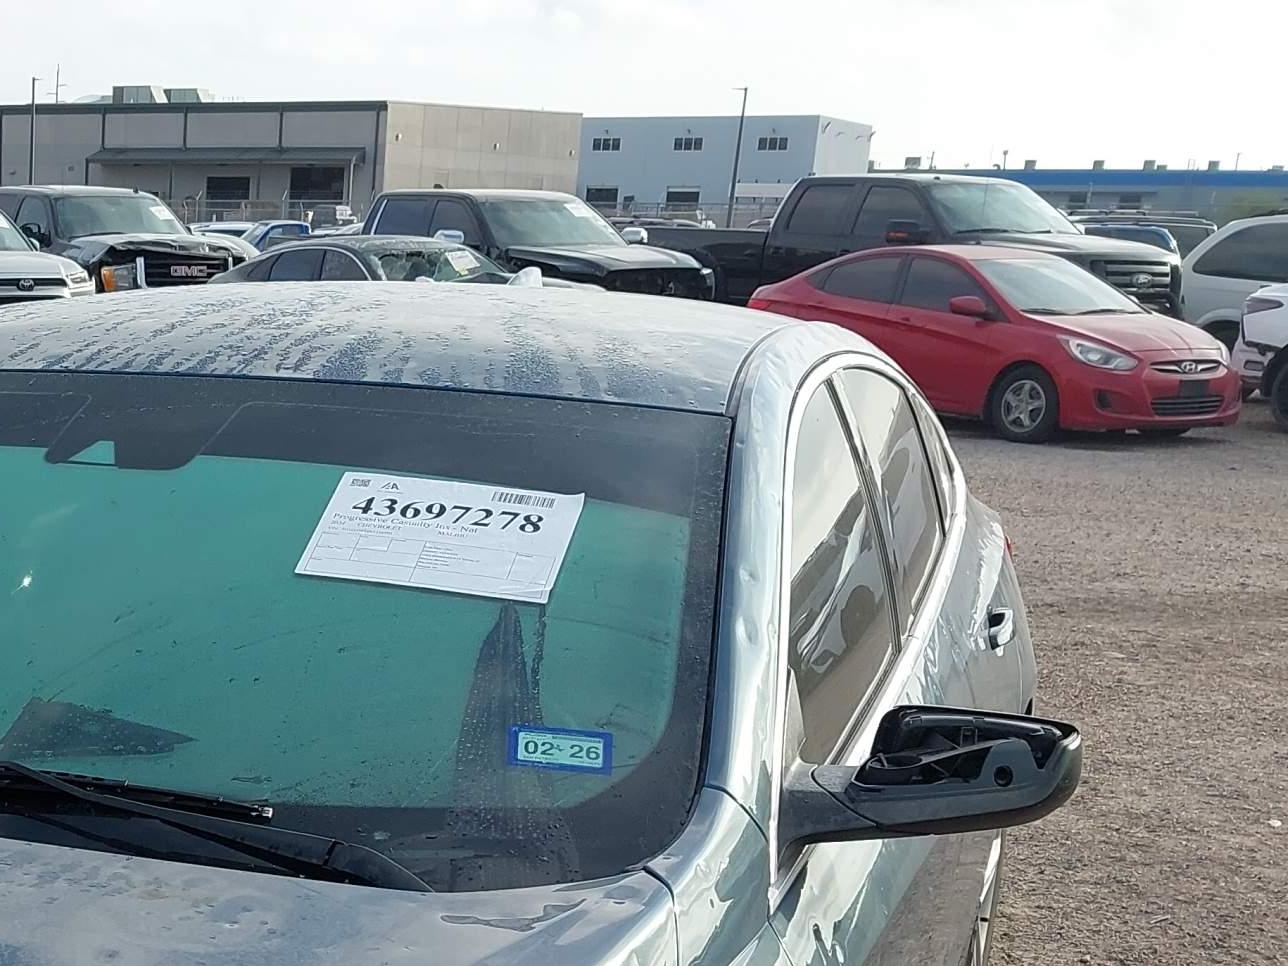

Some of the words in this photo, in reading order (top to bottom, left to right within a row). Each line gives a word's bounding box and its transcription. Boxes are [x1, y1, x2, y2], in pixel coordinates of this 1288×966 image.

[171, 265, 207, 277] GMC
[332, 512, 388, 524] Progressive
[351, 496, 544, 534] 43697278
[523, 740, 555, 756] 02
[569, 744, 601, 761] 26
